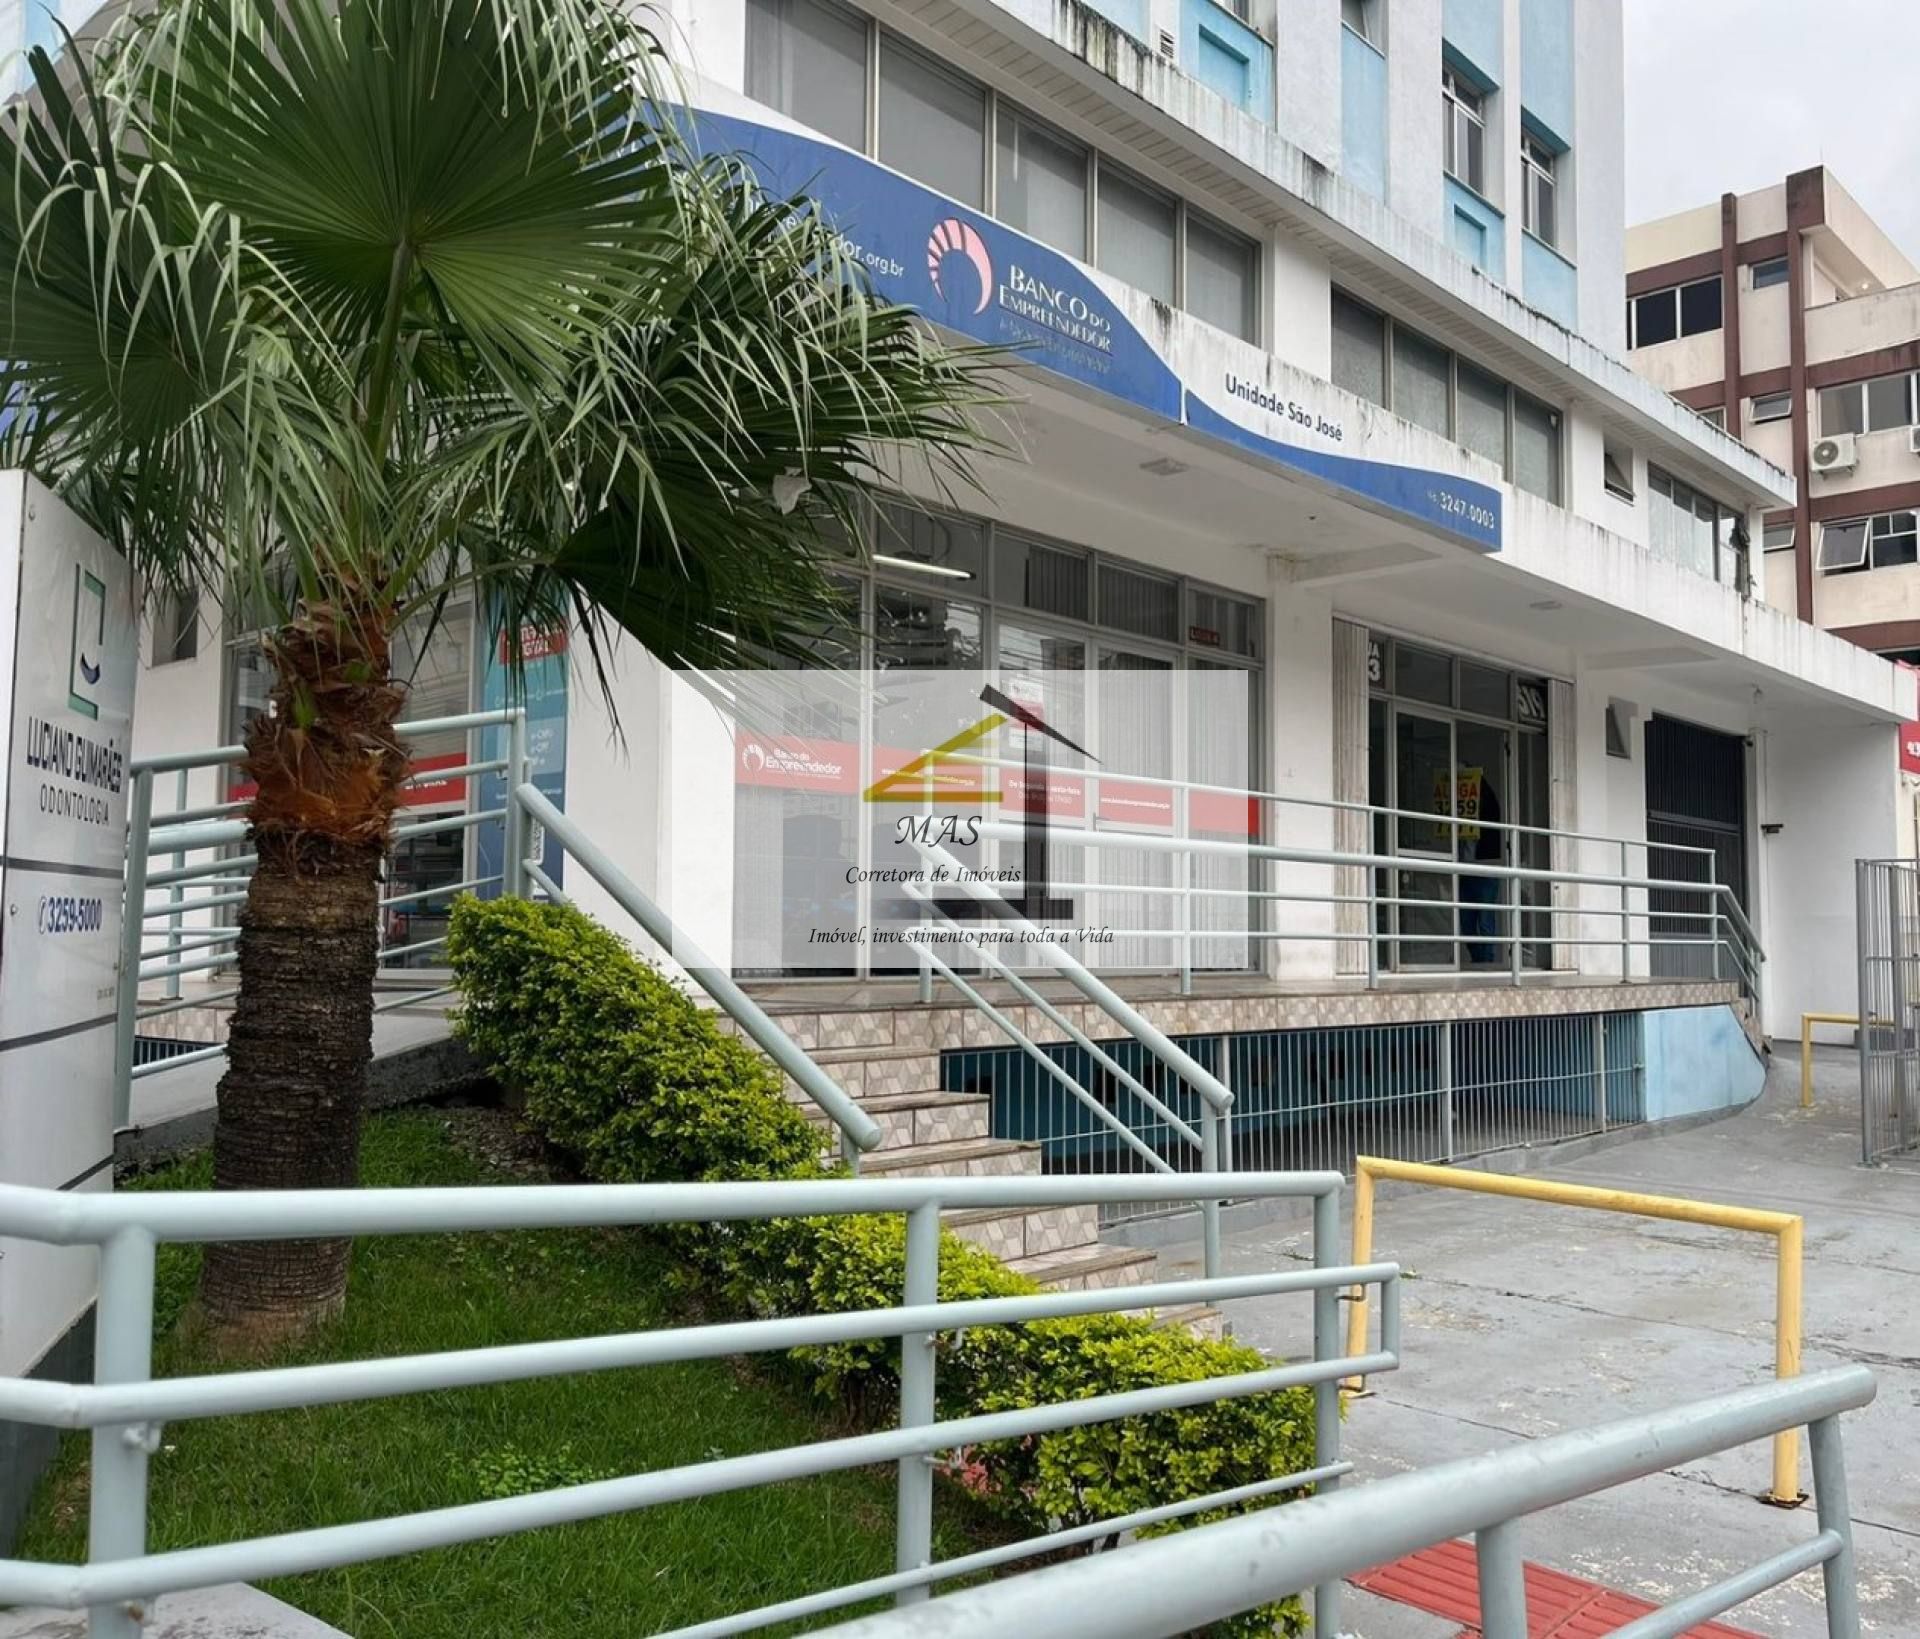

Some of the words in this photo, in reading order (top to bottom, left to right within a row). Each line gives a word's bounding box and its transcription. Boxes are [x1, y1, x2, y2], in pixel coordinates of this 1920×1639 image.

[999, 284, 1111, 353] EMPREENDEDOR
[1010, 264, 1088, 321] BANCO
[1089, 312, 1111, 332] DO
[1225, 373, 1284, 416] Unidade
[1288, 401, 1312, 428] São
[1315, 415, 1343, 442] José
[27, 716, 75, 778] LUCIANO
[75, 736, 122, 793] GUIMARÃES
[40, 783, 110, 826] ODONTOLOGIA
[47, 897, 103, 932] 3259-5000
